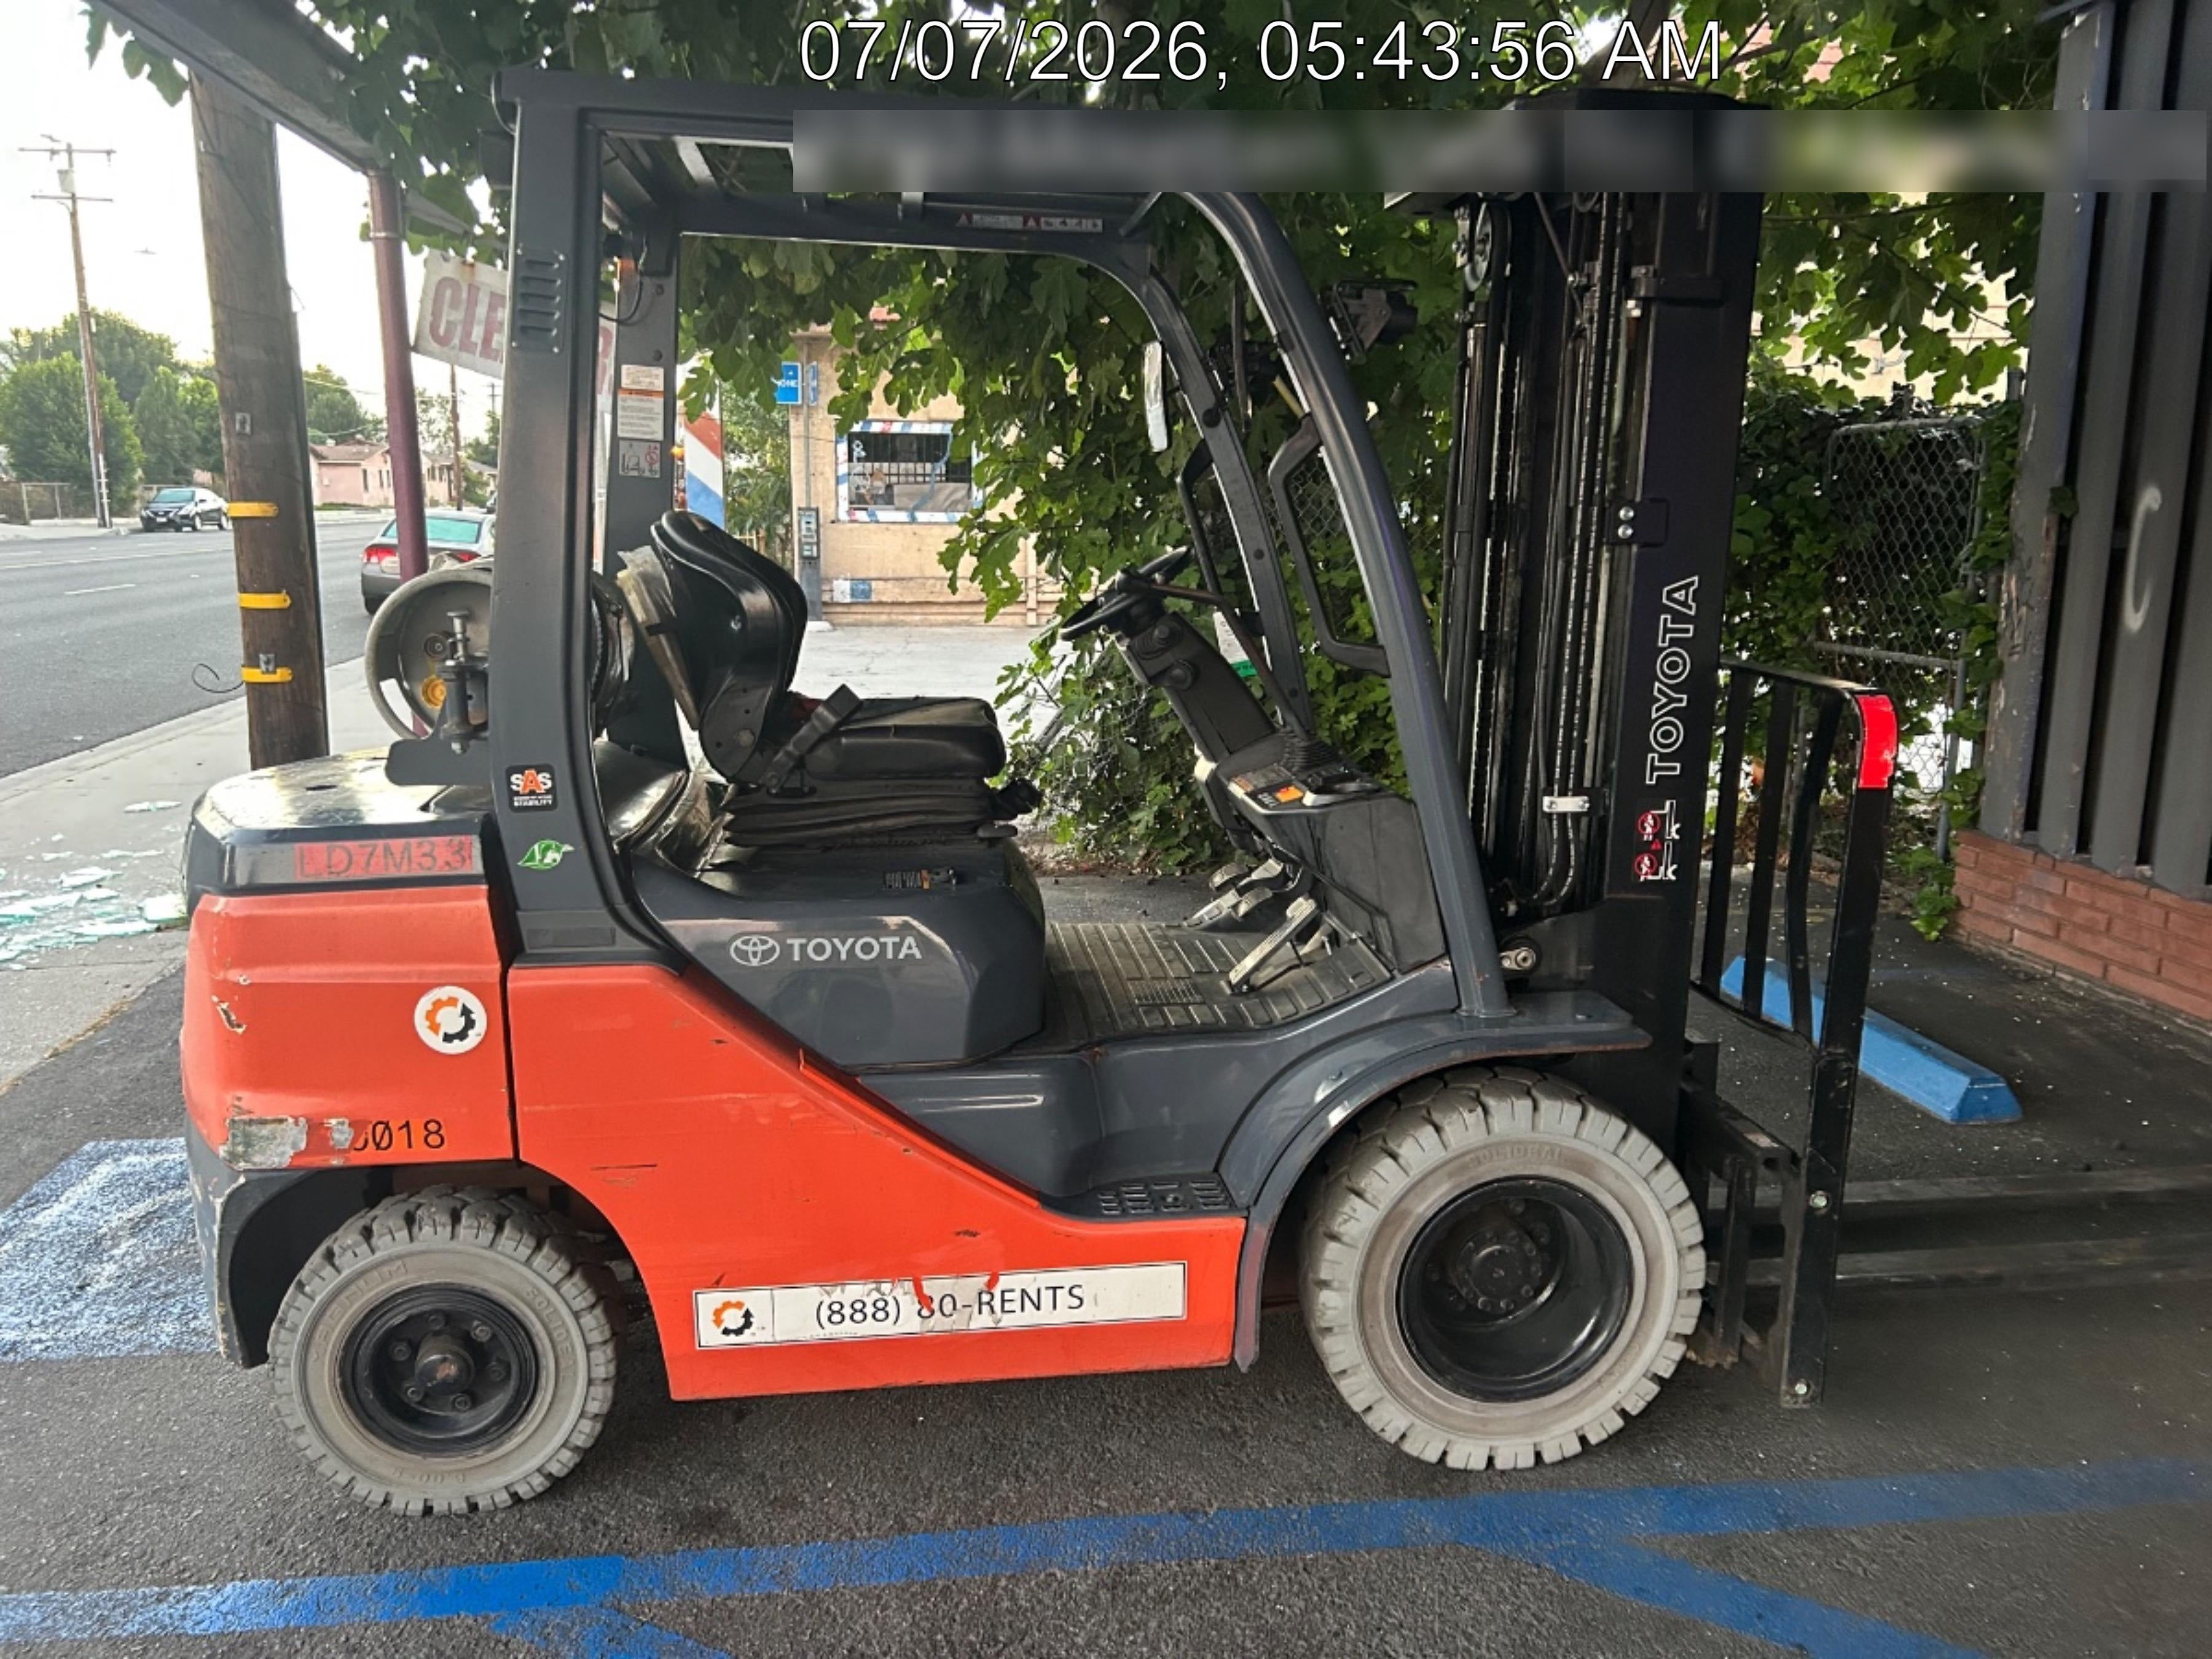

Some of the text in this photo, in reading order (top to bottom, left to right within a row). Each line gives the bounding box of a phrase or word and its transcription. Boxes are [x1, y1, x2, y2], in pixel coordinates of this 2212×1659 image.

[1645, 575, 1699, 785] TOYOTA
[509, 768, 553, 794] SAS
[298, 836, 466, 878] LD7M33
[786, 936, 922, 962] TOYOTA
[815, 1284, 1085, 1330] (888) 80-RENTS
